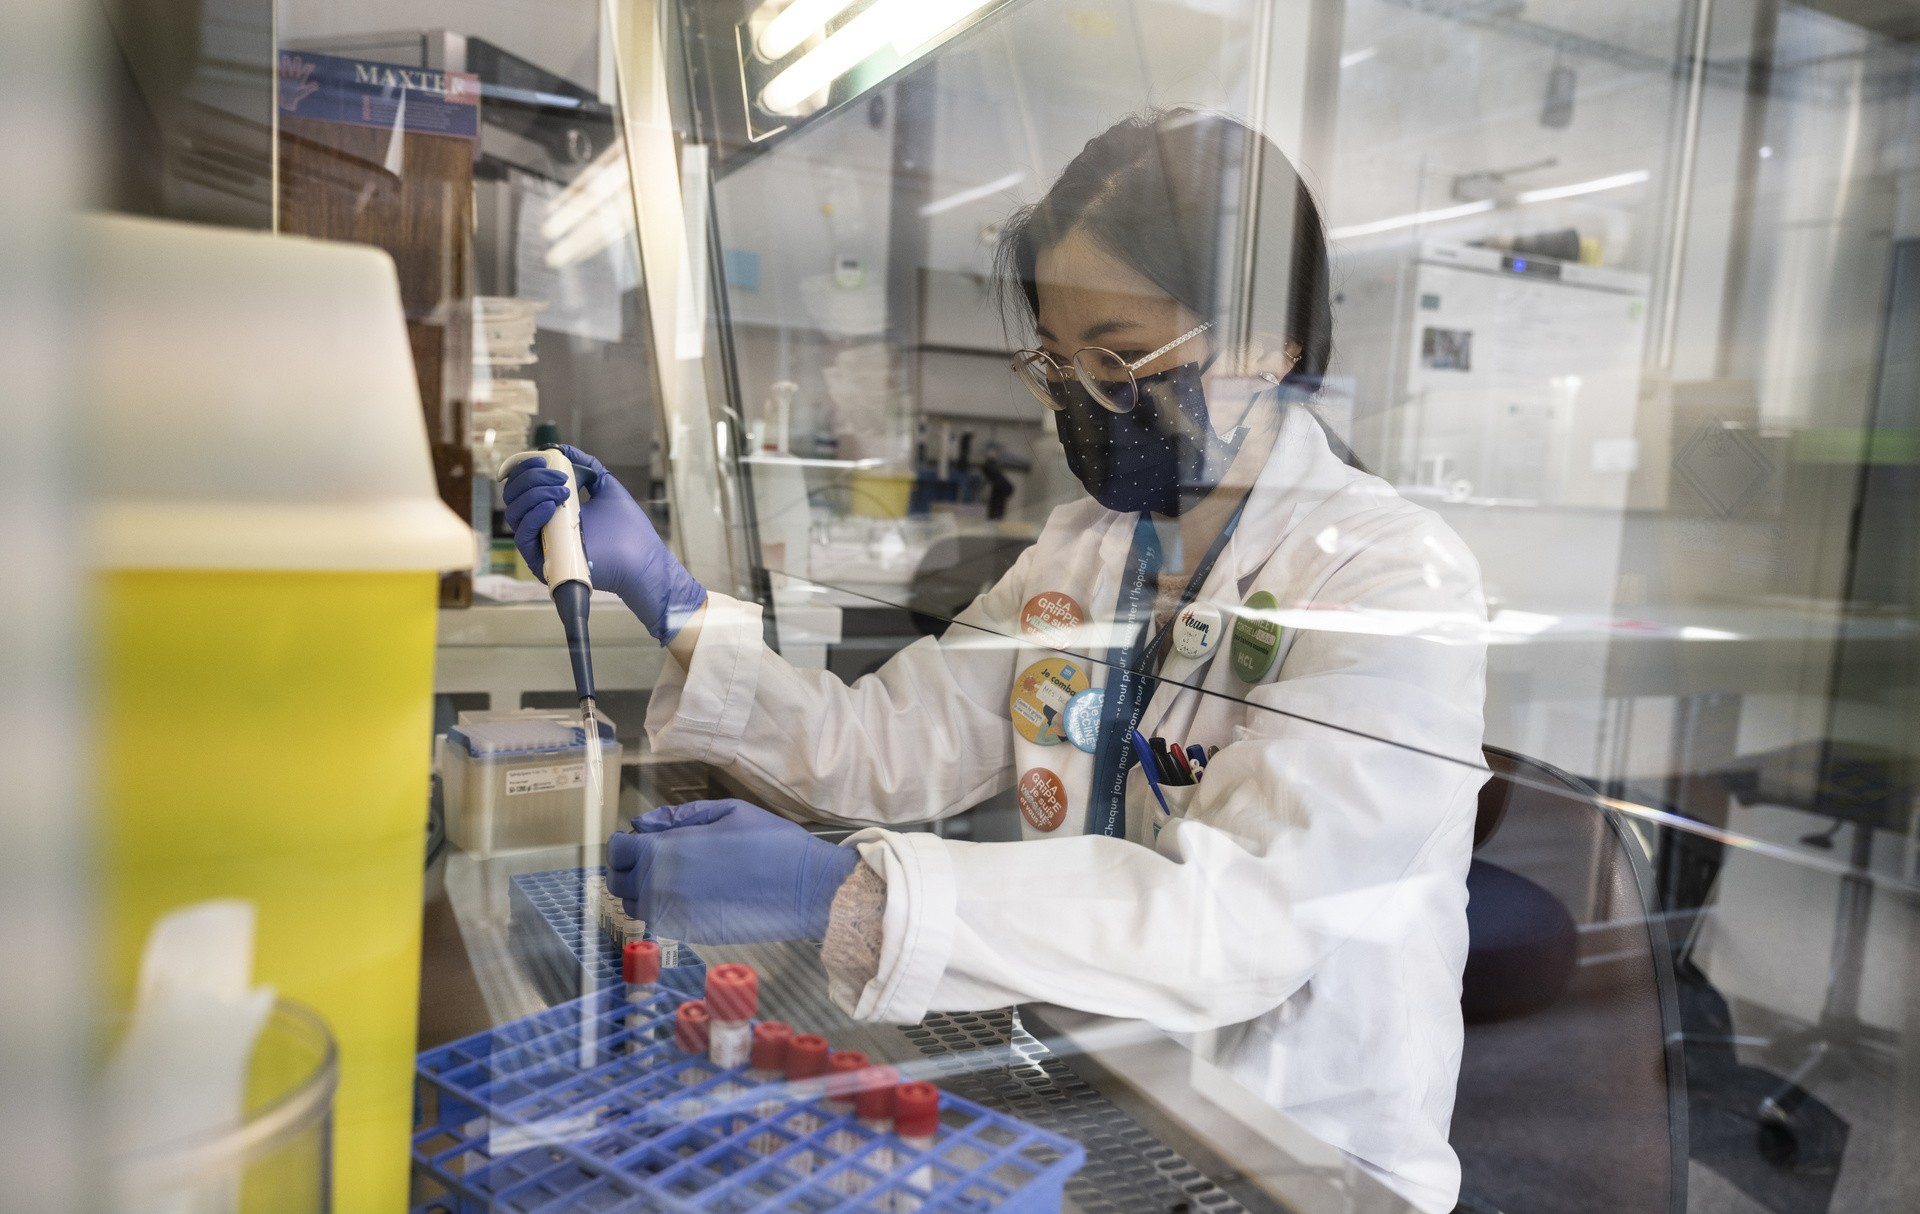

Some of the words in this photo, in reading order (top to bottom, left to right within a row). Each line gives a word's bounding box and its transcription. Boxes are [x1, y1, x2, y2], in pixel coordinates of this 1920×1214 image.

[1056, 598, 1071, 612] LA
[1237, 652, 1254, 670] HCL
[1041, 668, 1051, 678] Je
[1051, 677, 1077, 697] comba
[1118, 684, 1128, 705] tout
[1134, 685, 1144, 705] tout
[1088, 705, 1099, 717] je
[1121, 707, 1140, 743] faisons
[1119, 746, 1130, 770] nous
[1046, 778, 1058, 795] LA
[1039, 798, 1054, 818] suis
[1104, 797, 1118, 837] Chaque
